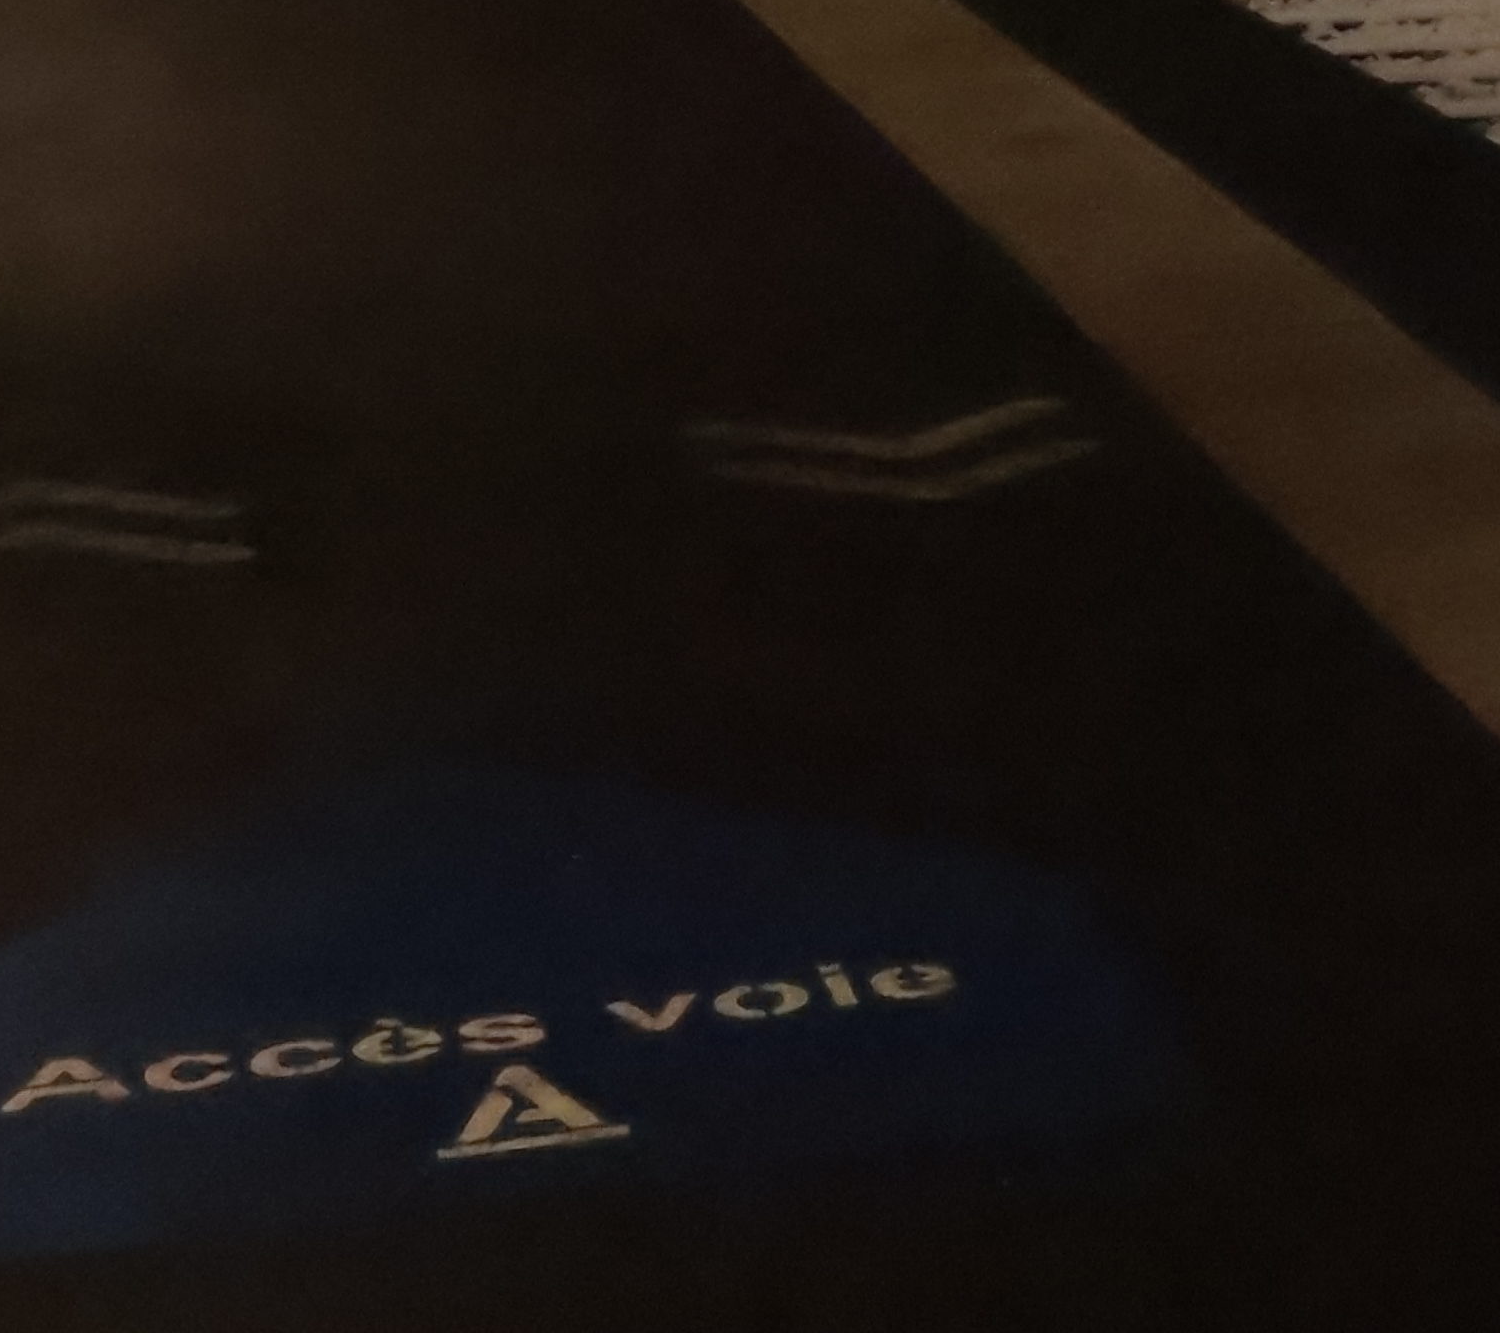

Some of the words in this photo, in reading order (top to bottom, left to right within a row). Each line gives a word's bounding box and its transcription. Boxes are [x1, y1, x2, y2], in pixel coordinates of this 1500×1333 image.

[0, 1011, 548, 1115] Accès
[606, 959, 957, 1033] voie
[454, 1062, 606, 1147] A
